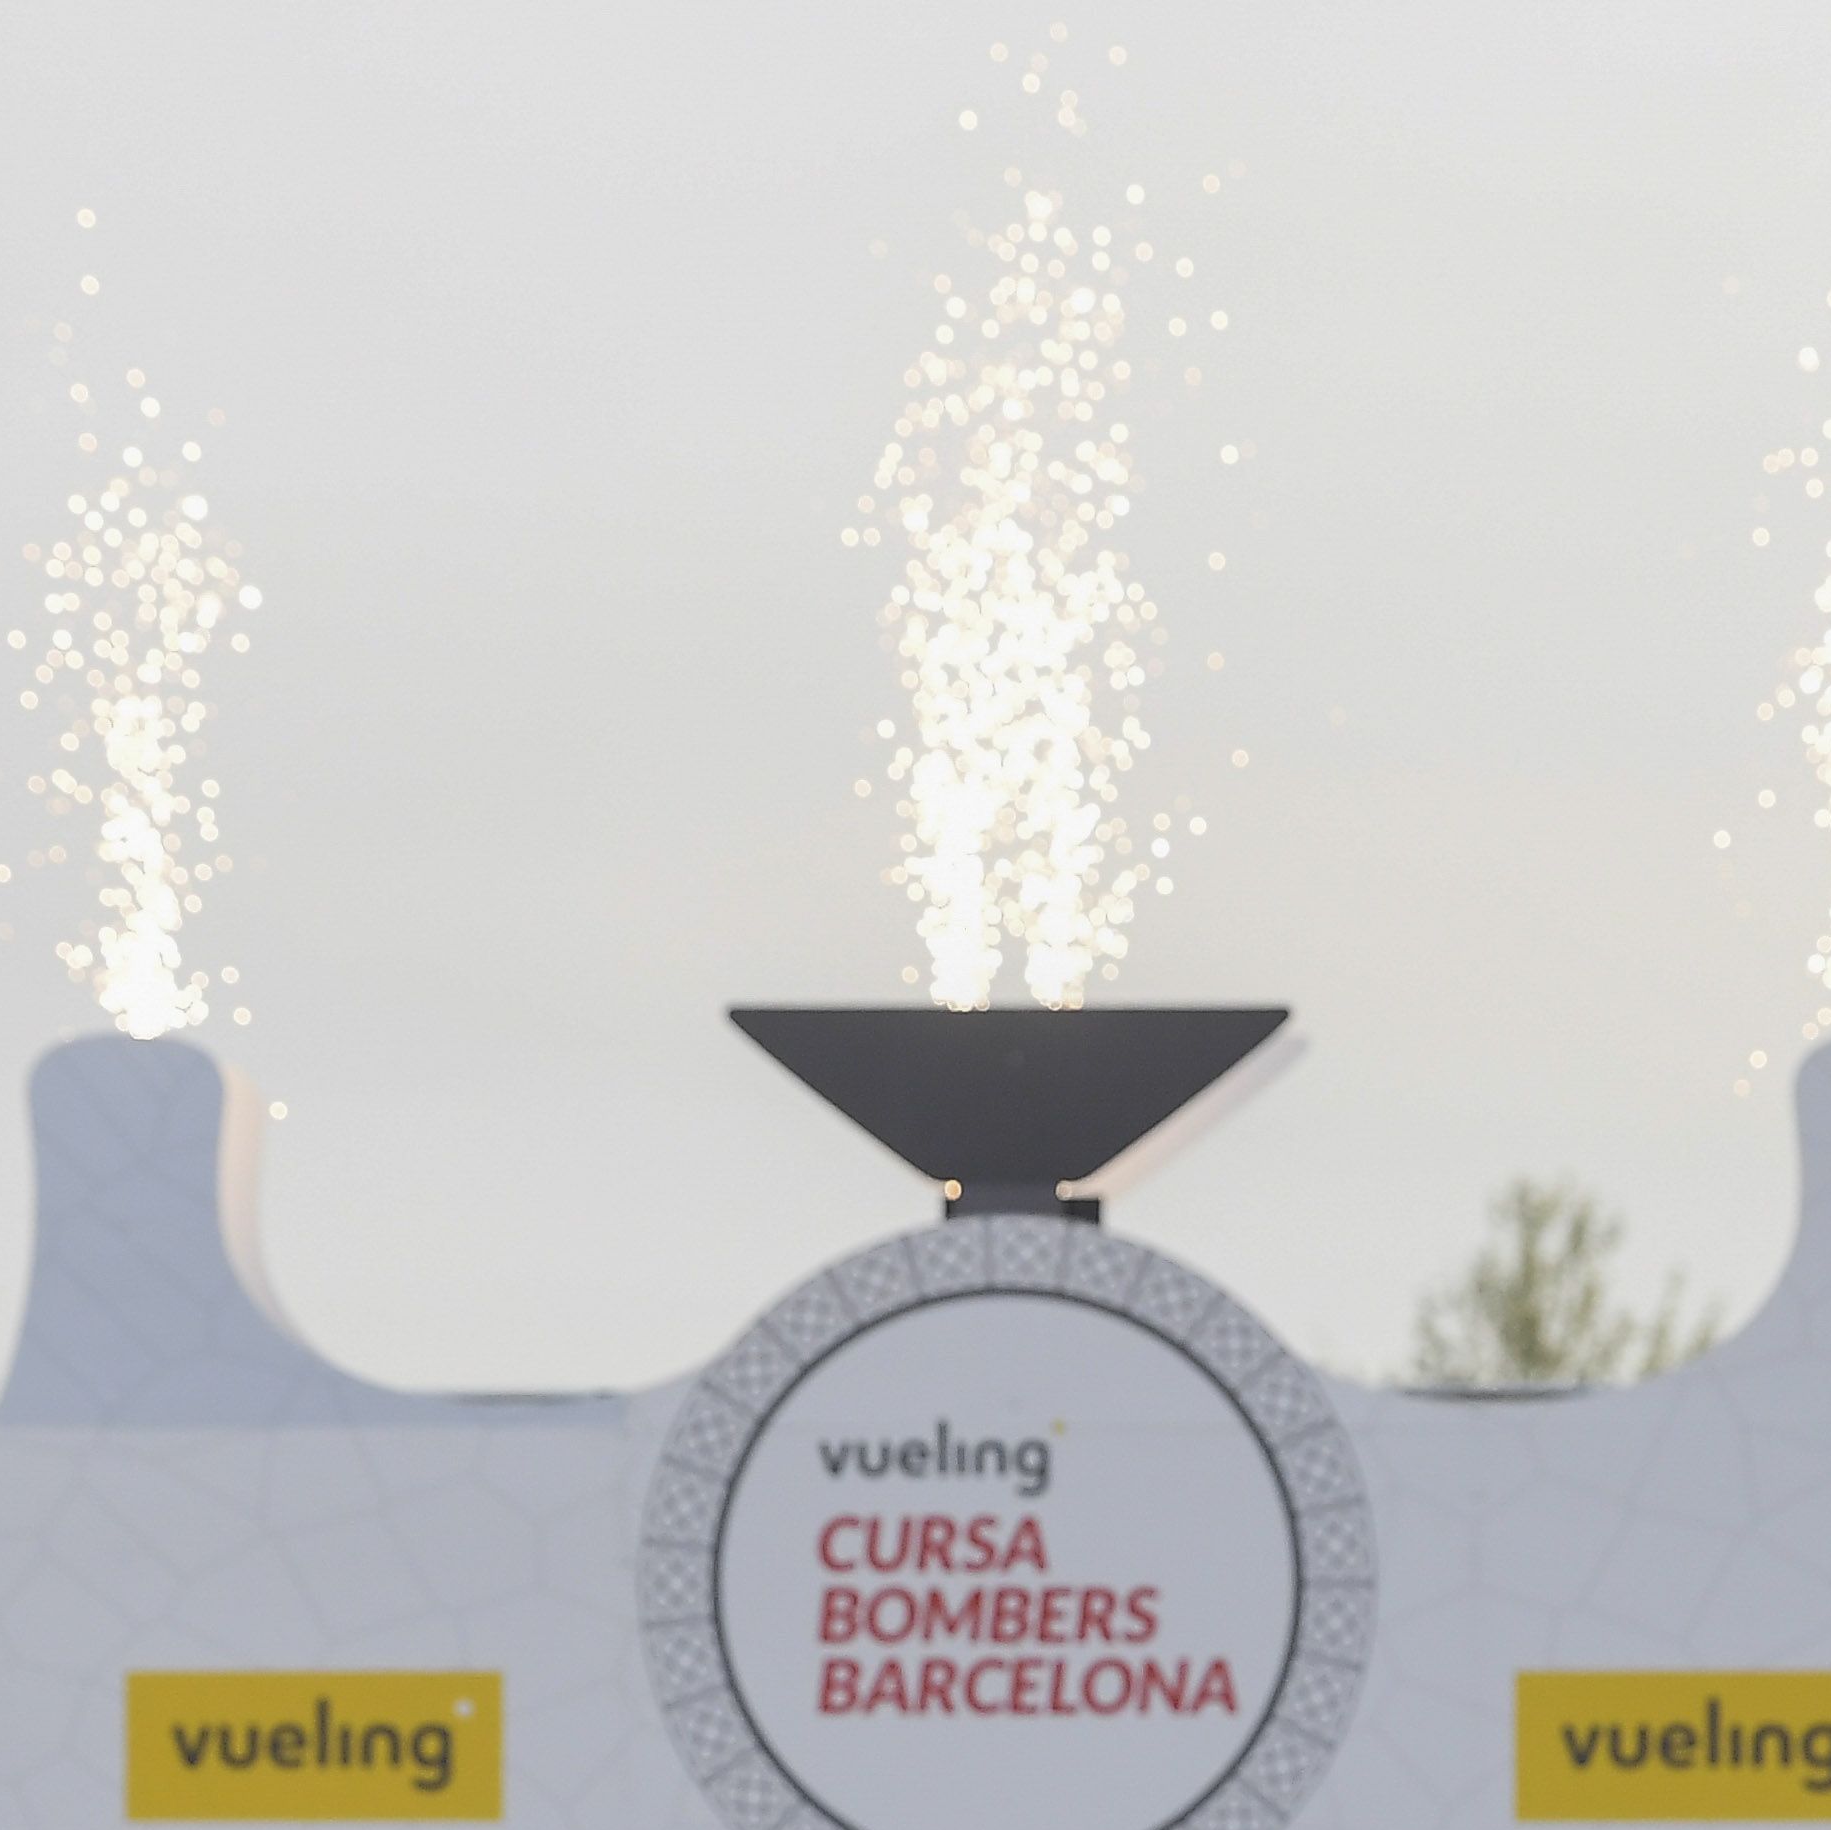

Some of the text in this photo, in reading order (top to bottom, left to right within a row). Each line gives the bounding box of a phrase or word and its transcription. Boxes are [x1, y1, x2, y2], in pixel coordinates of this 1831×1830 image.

[820, 1421, 1052, 1495] vueling
[821, 1515, 1048, 1574] CURSA
[820, 1587, 1159, 1646] BOMBERS
[819, 1657, 1237, 1717] BARCELONA
[173, 1699, 452, 1791] vueling
